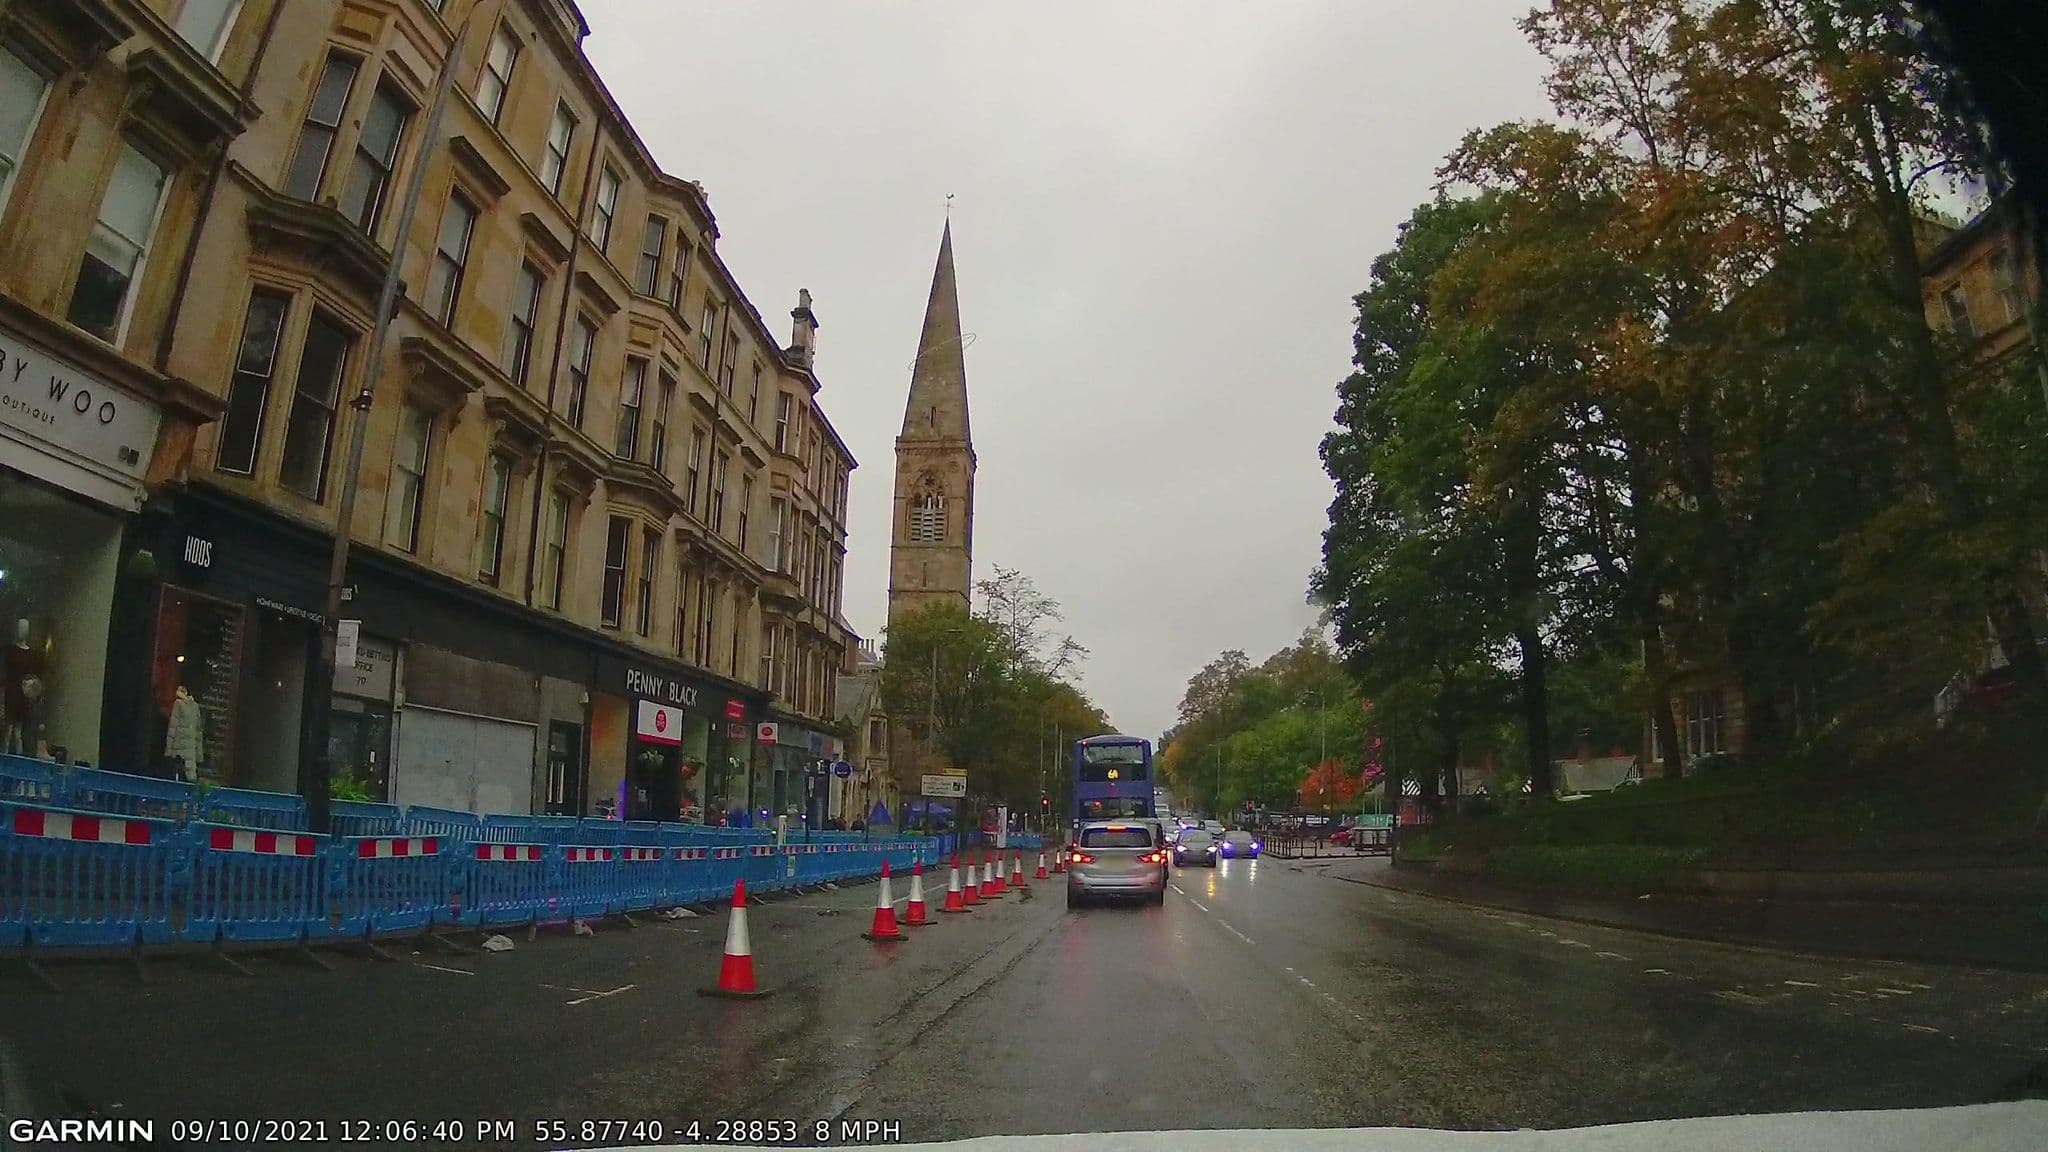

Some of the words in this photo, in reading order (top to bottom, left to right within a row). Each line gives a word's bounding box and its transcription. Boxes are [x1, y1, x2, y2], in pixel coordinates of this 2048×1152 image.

[49, 375, 116, 424] WOO
[184, 535, 213, 568] HOOS
[626, 668, 664, 697] PENNY
[669, 681, 698, 707] BLACK
